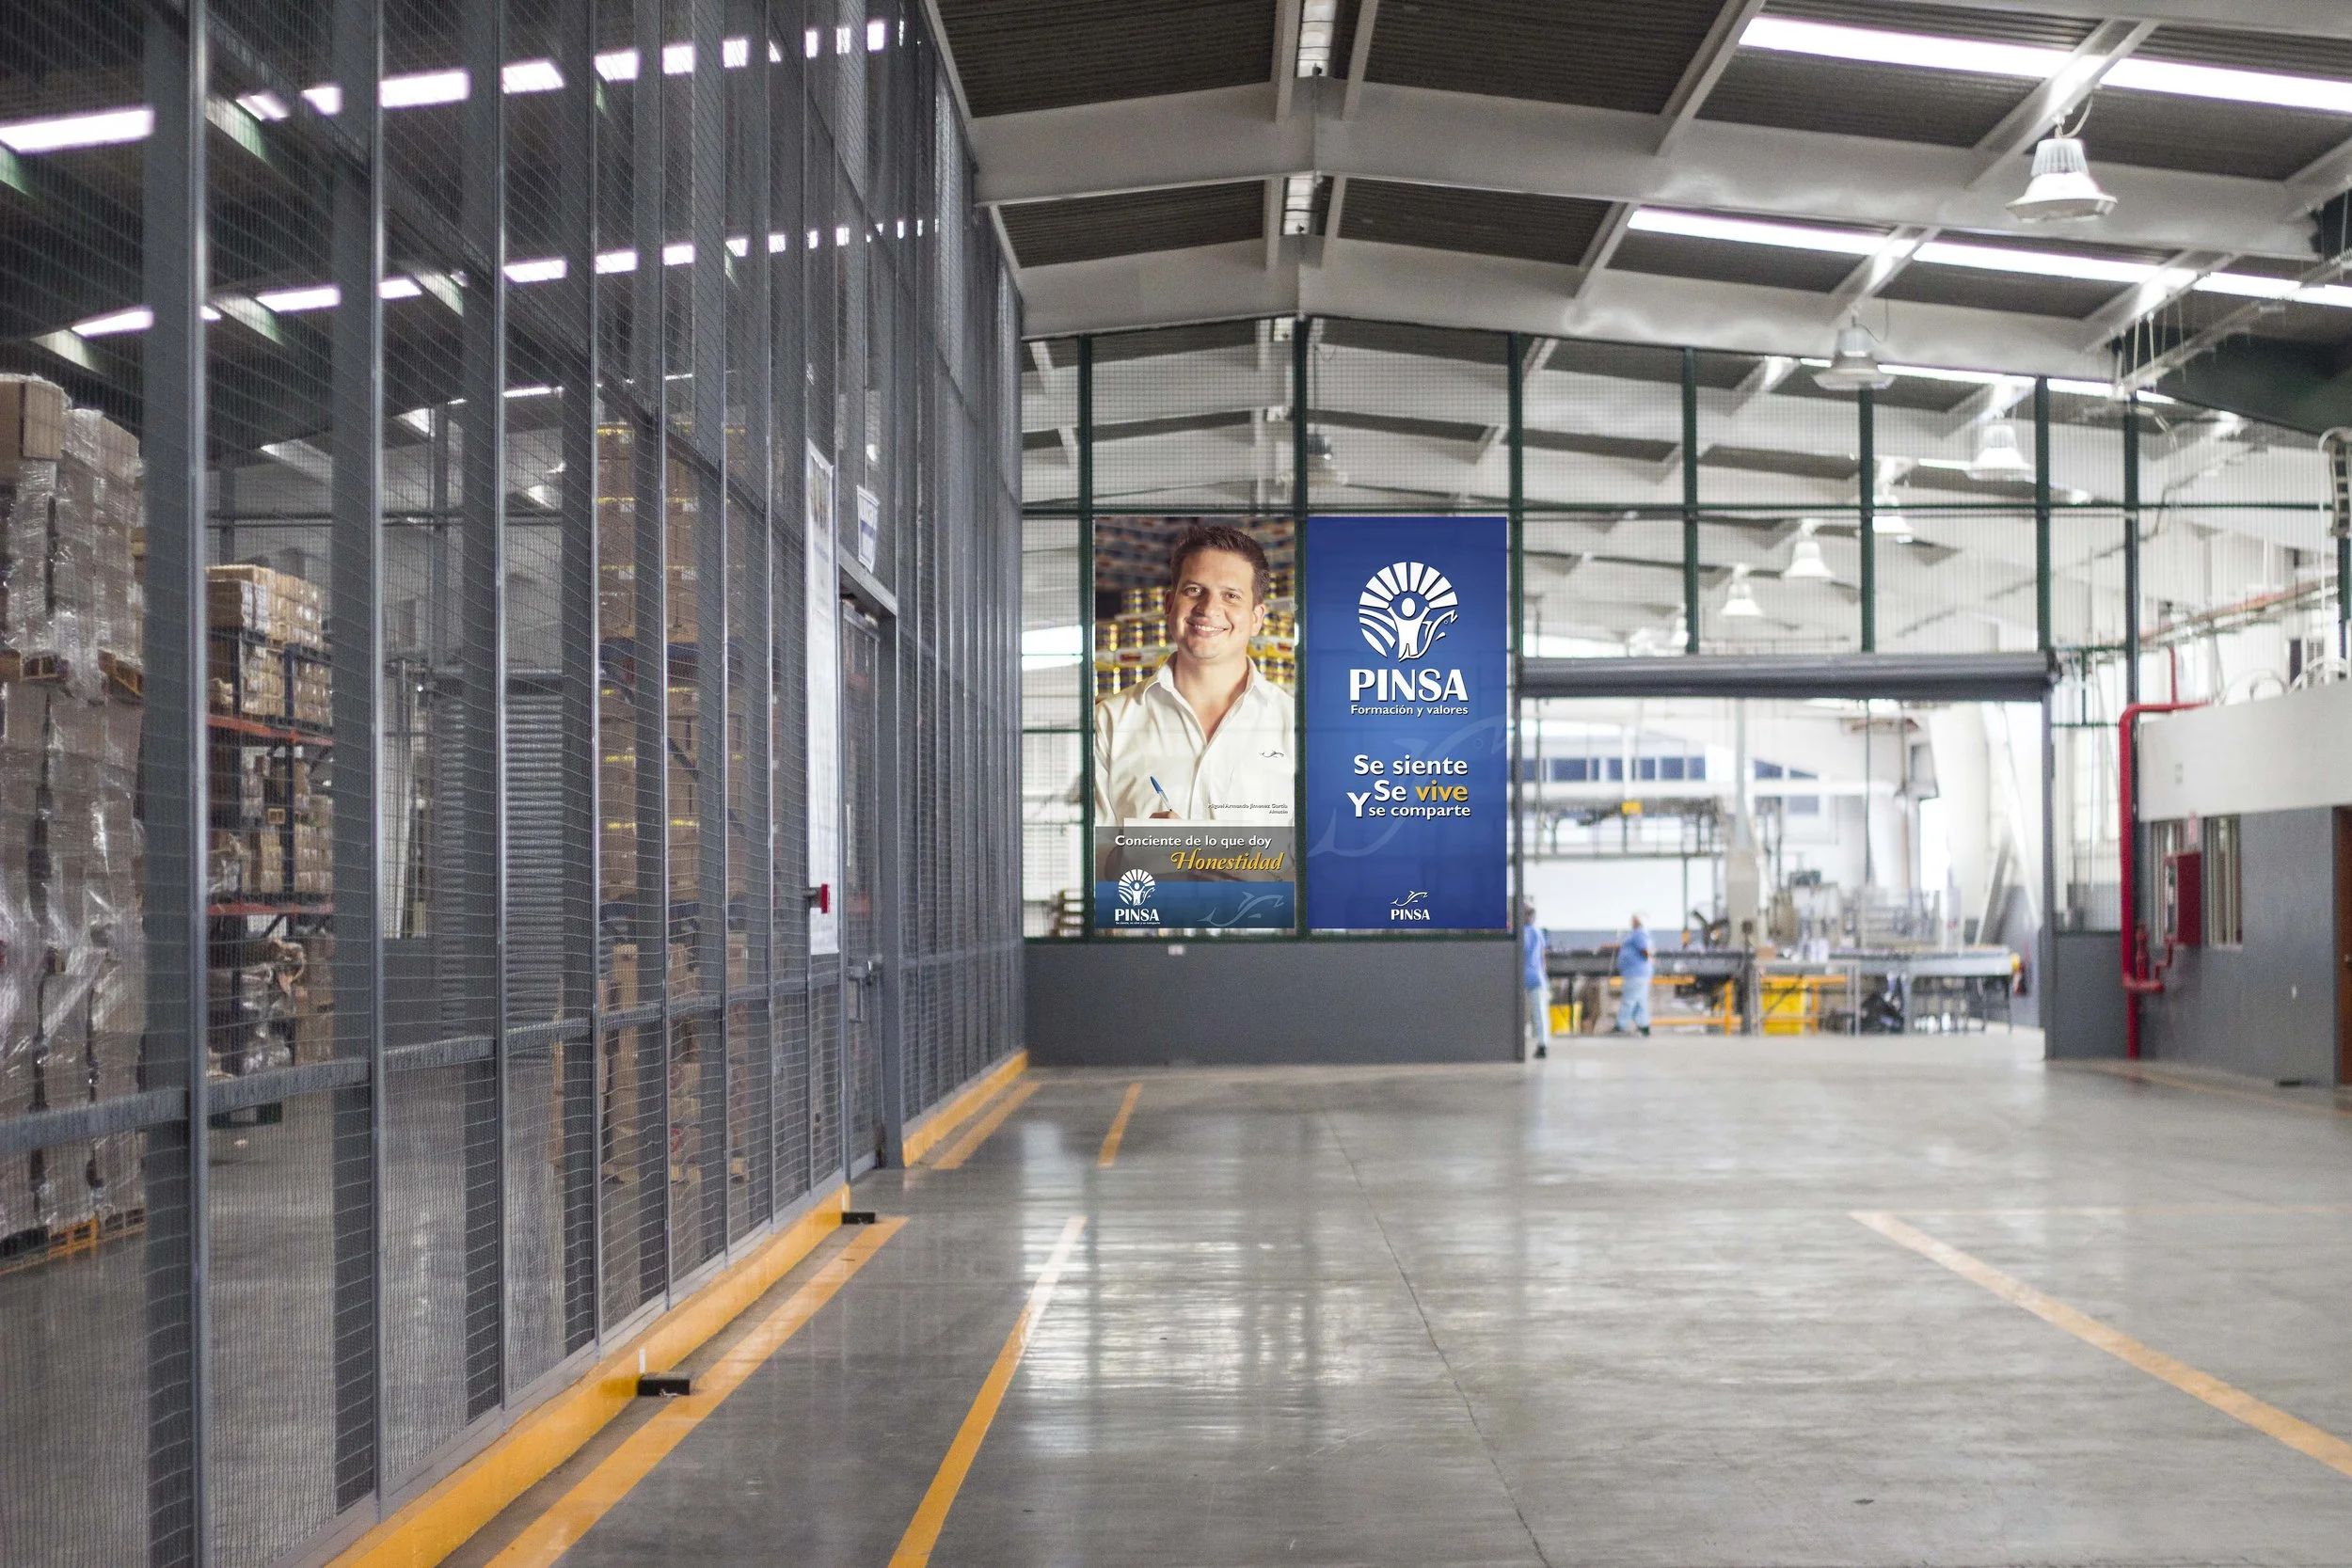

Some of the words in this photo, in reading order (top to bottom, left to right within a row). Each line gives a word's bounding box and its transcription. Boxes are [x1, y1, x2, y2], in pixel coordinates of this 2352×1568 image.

[1350, 669, 1469, 702] PINSA
[1351, 705, 1414, 716] Formación
[1417, 706, 1424, 718] y
[1426, 705, 1469, 716] valores
[1354, 754, 1385, 775] Se
[1392, 754, 1469, 775] siente
[1374, 780, 1407, 801] Se
[1415, 780, 1469, 801] vive
[1346, 792, 1372, 818] Y
[1369, 805, 1386, 816] se
[1391, 804, 1471, 820] comparte
[1115, 835, 1182, 847] Conciente
[1185, 835, 1201, 847] de
[1205, 835, 1217, 847] lo
[1221, 837, 1245, 849] que
[1248, 835, 1272, 849] doy
[1170, 847, 1285, 871] Honestidad
[1115, 909, 1160, 922] PINSA
[1391, 909, 1431, 921] PINSA
